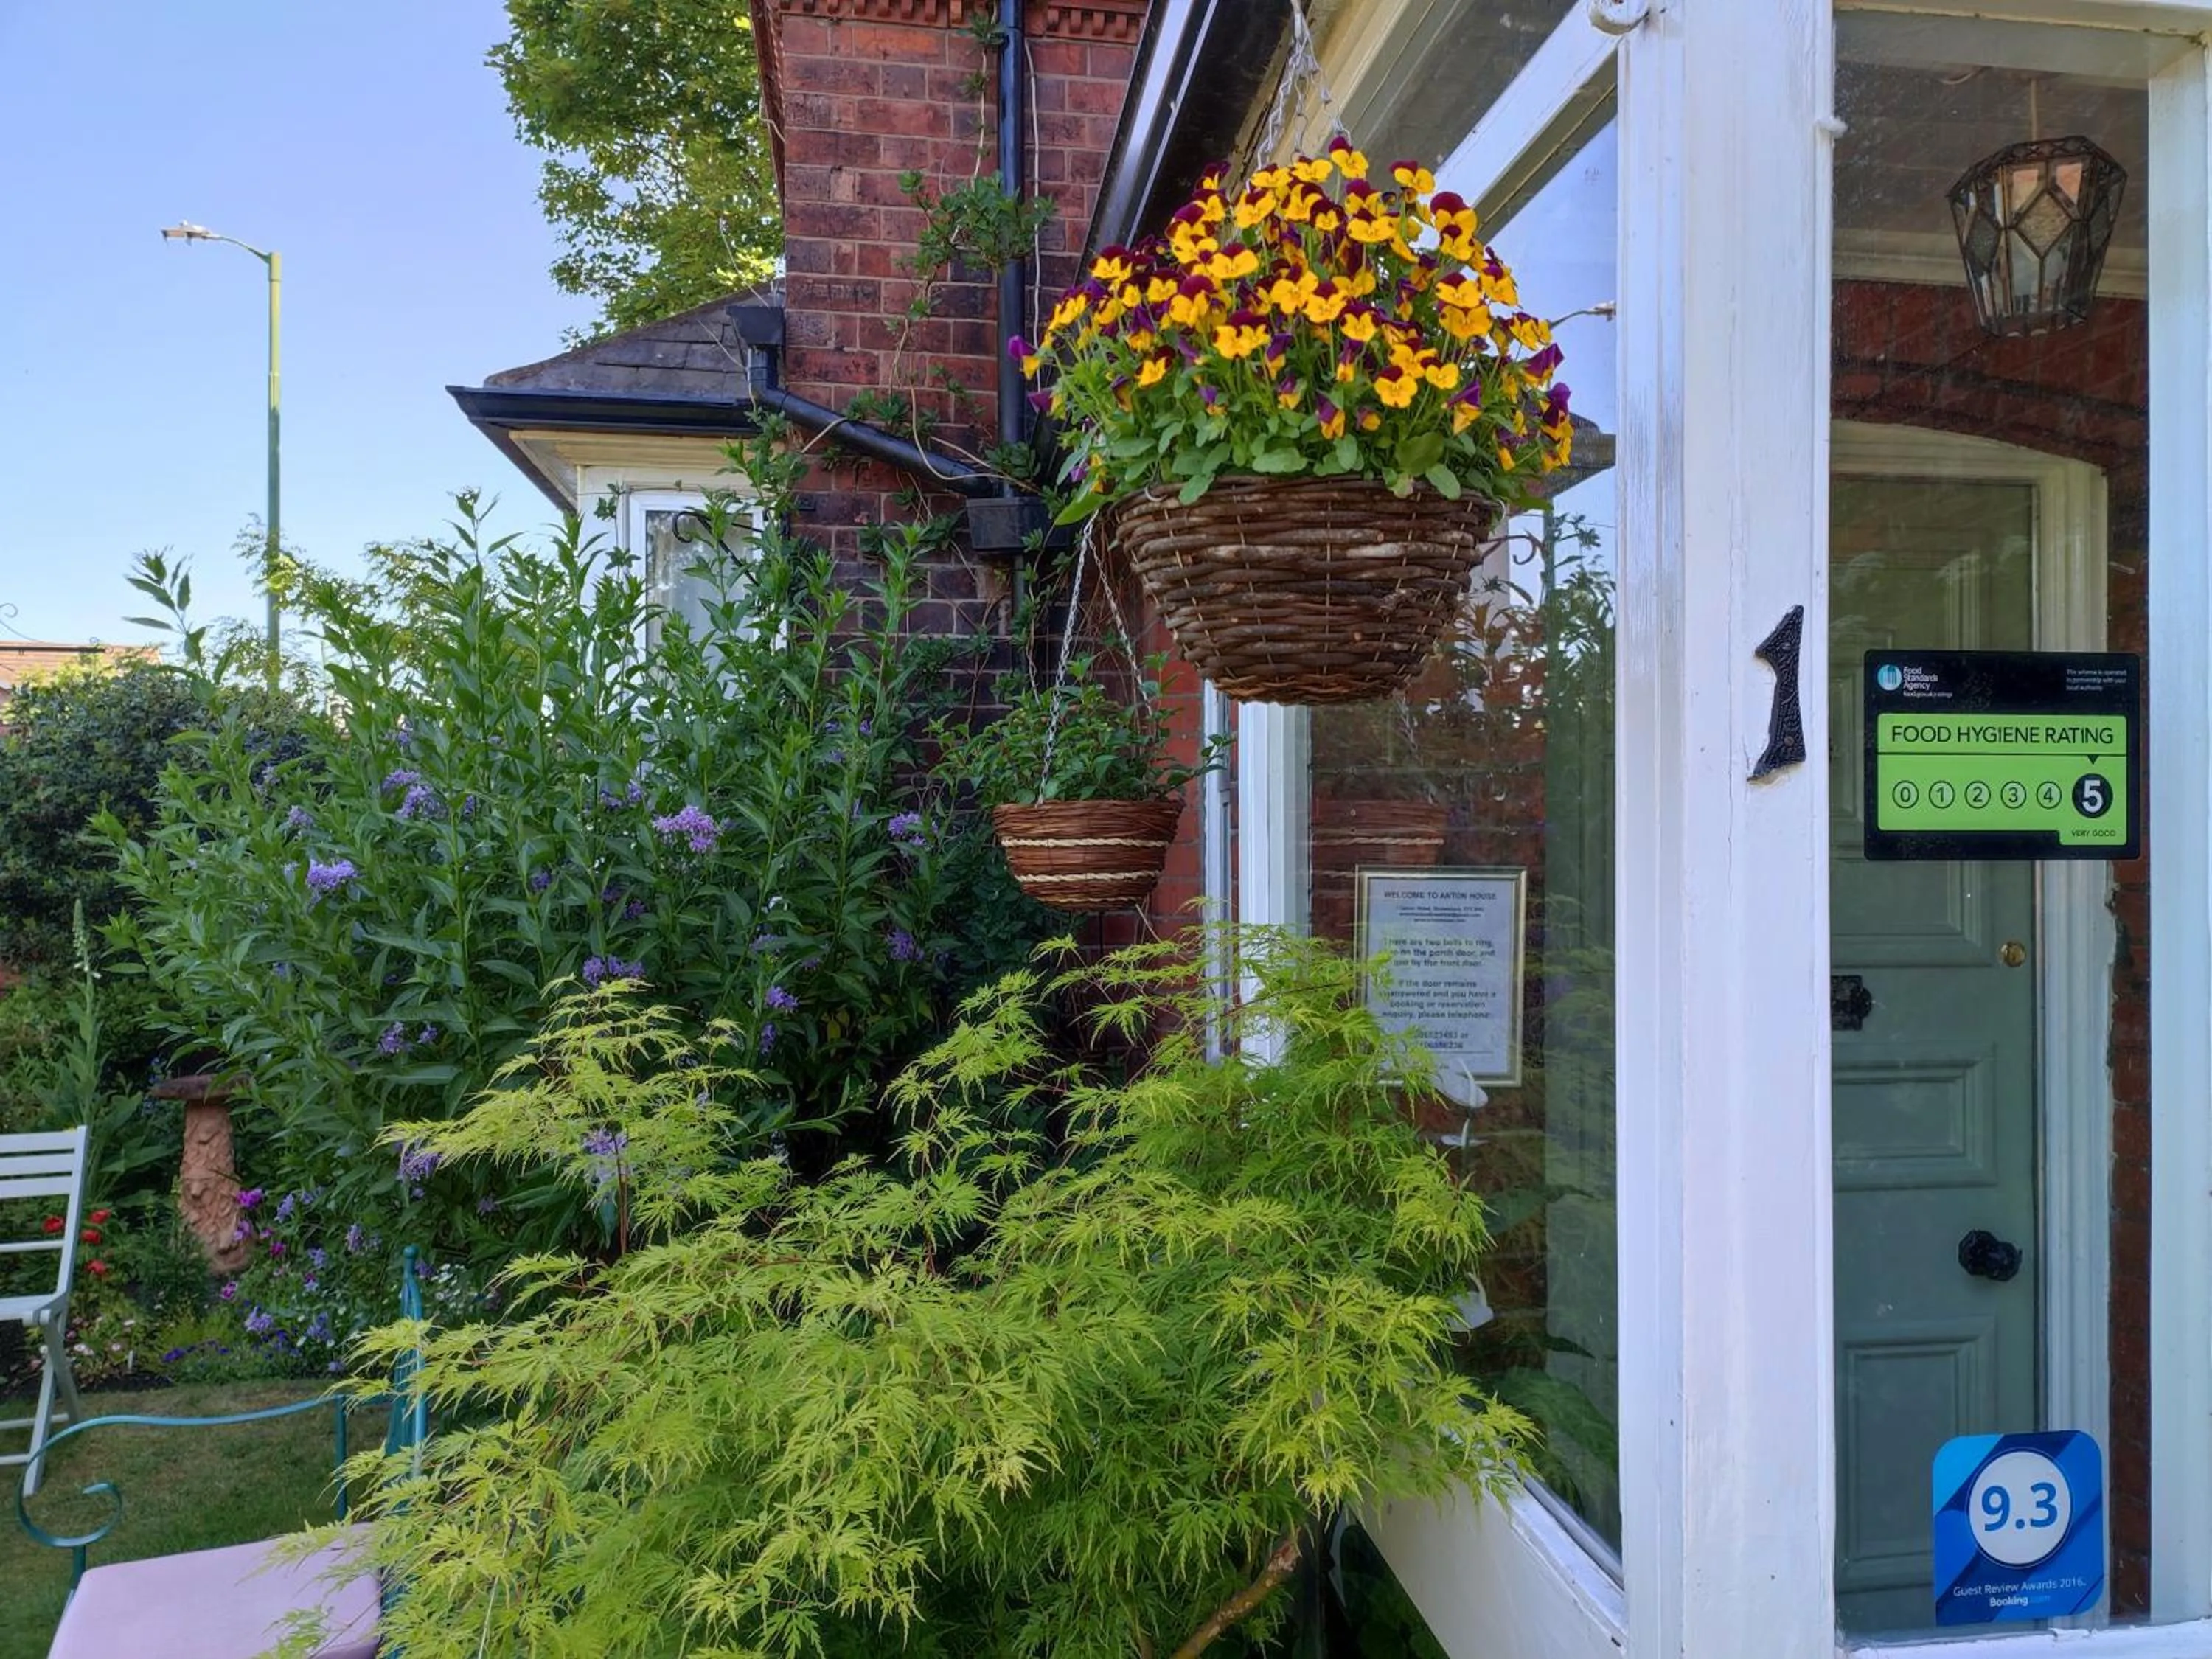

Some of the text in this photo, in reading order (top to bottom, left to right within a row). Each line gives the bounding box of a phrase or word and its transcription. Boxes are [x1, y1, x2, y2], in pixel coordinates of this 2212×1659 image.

[1903, 674, 1938, 682] Standards
[1903, 681, 1931, 691] Agency
[1747, 605, 1806, 781] 1
[1891, 726, 2114, 744] FOOD HYGIENE RATING
[1900, 779, 2104, 813] 0 1 2 3 4 5
[1384, 891, 1425, 900] WELCOME
[1427, 891, 1439, 900] TO
[1470, 892, 1497, 900] HOUSE
[1413, 948, 1427, 956] the
[1428, 948, 1453, 958] porch
[1411, 959, 1421, 968] by
[1405, 979, 1420, 987] the
[1422, 979, 1441, 987] door
[1444, 979, 1477, 987] remains
[1390, 1001, 1424, 1009] booking
[1438, 1001, 1486, 1009] reservation
[1418, 1011, 1446, 1019] please
[1981, 1482, 2058, 1531] 9.3
[1953, 1586, 1983, 1597] Guest
[1984, 1583, 2020, 1594] Review
[2020, 1579, 2058, 1592] Awards
